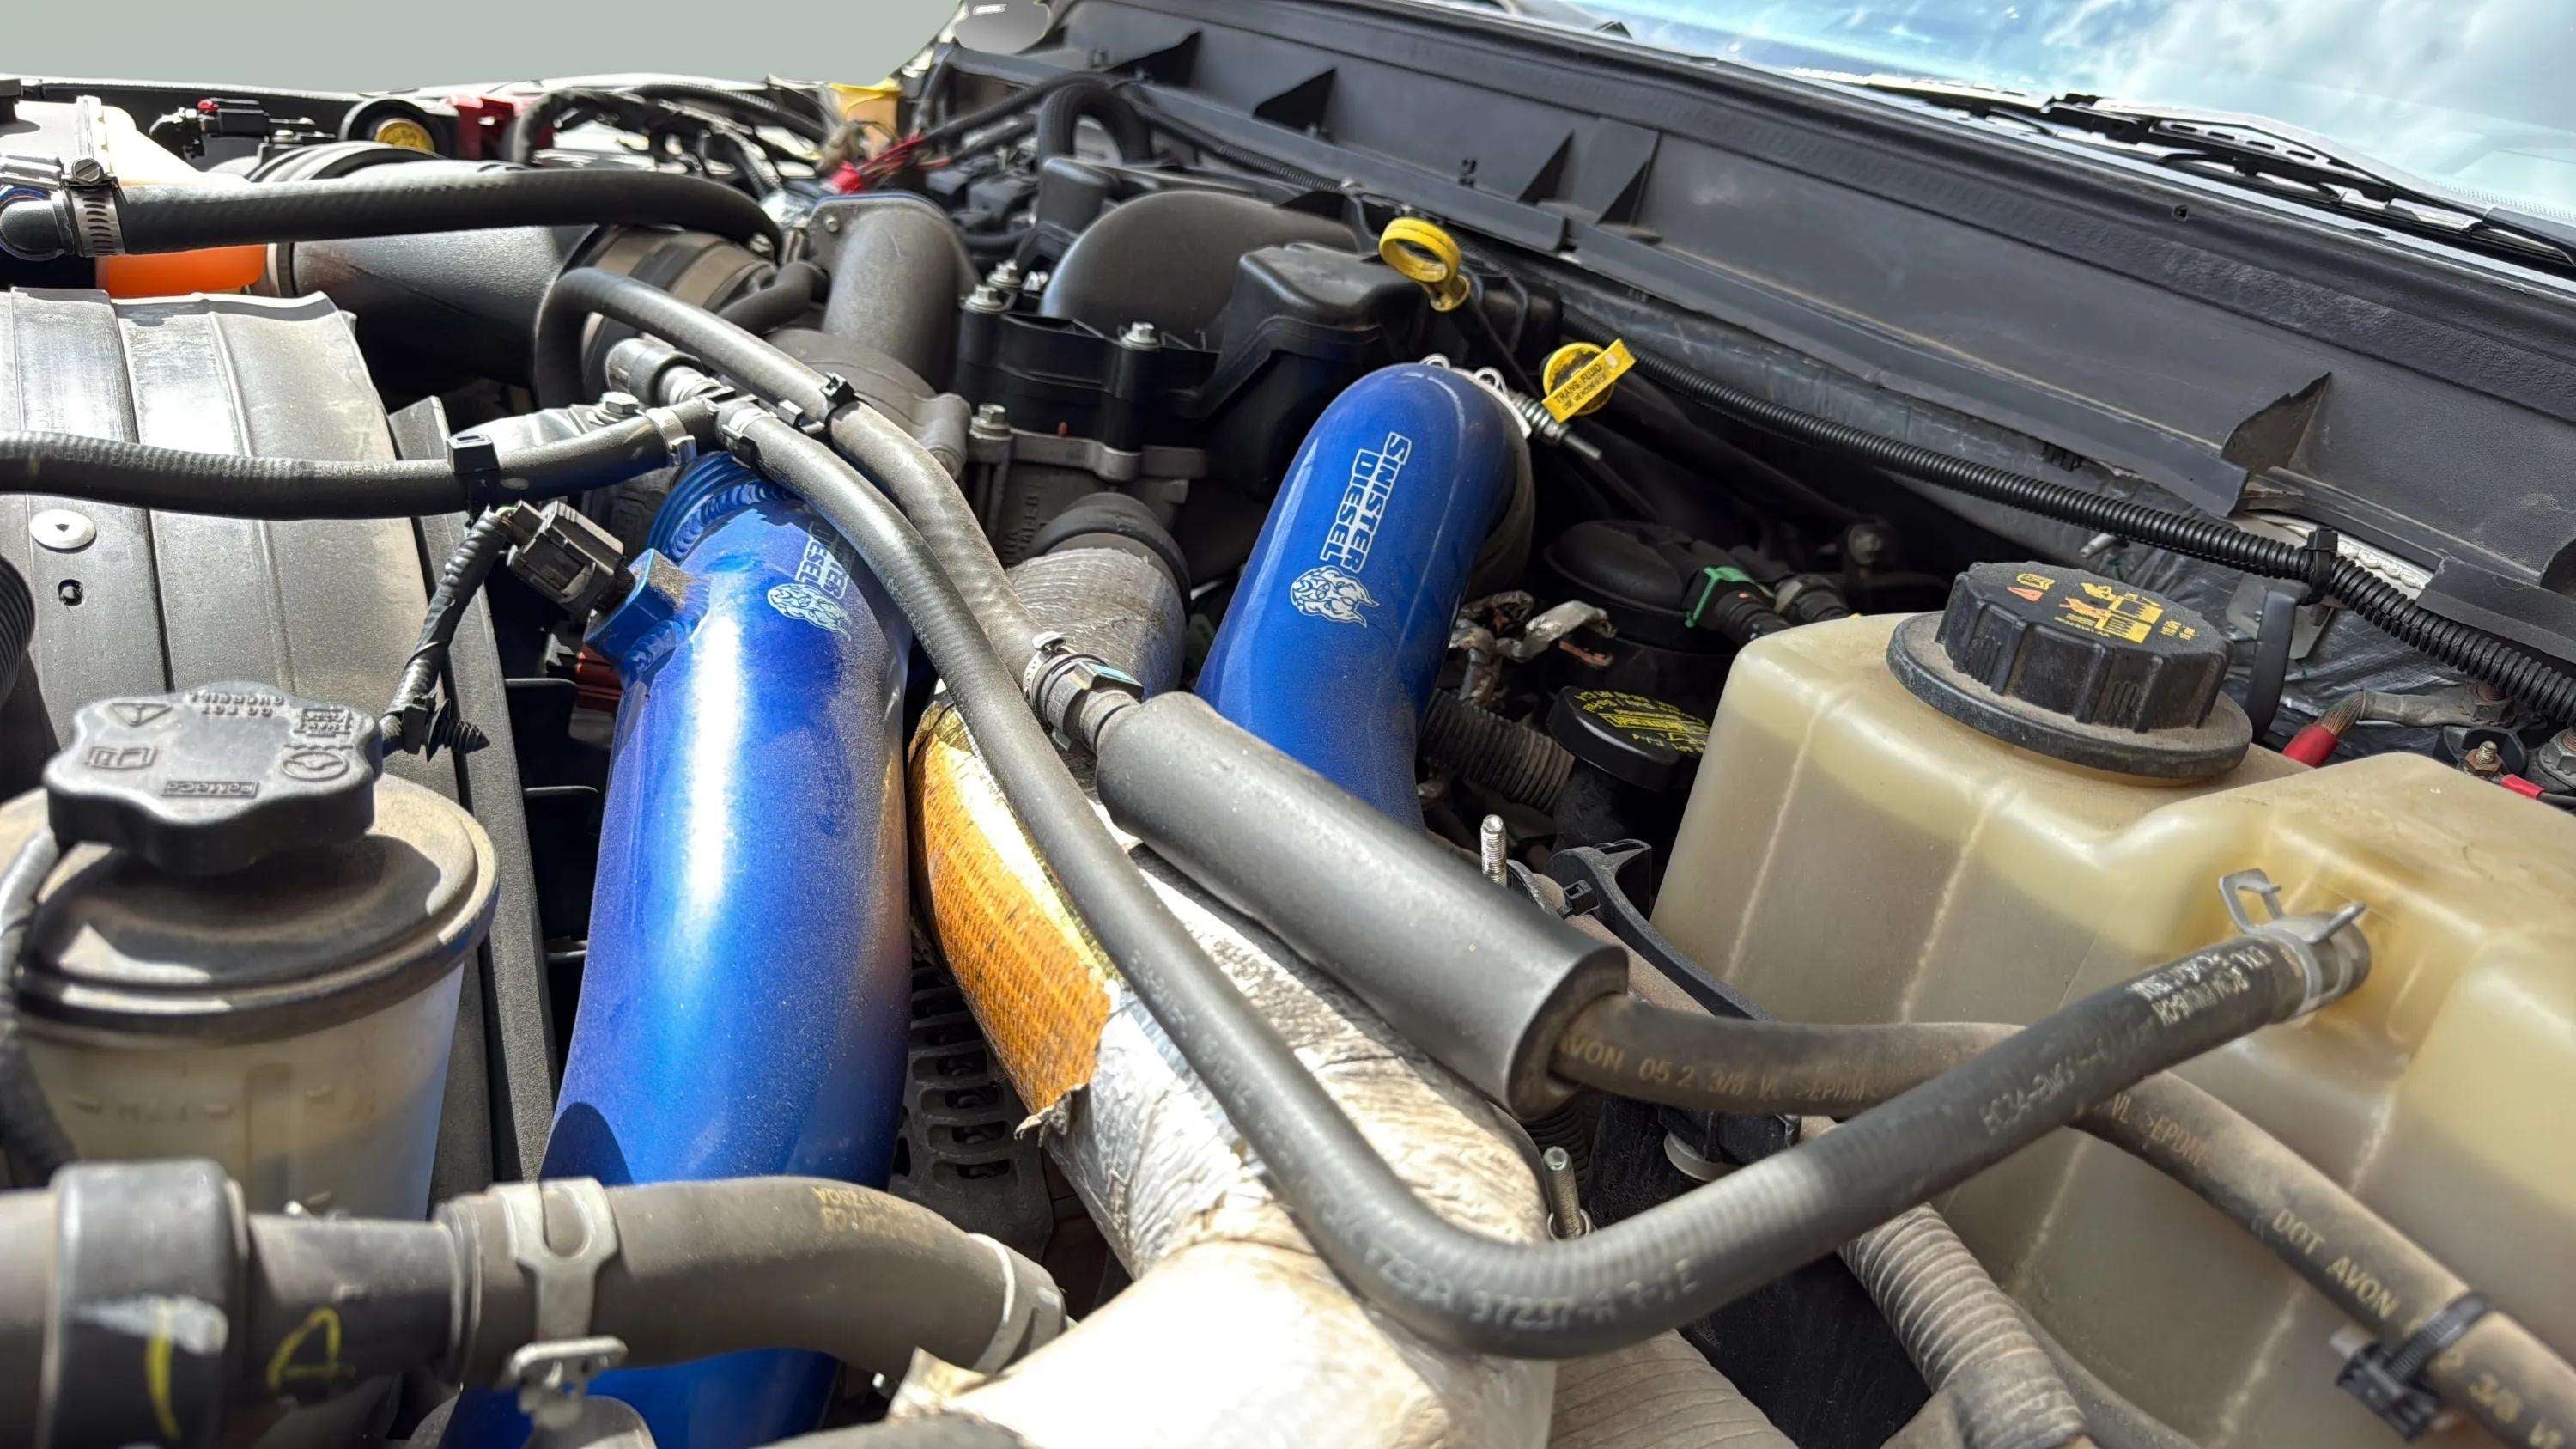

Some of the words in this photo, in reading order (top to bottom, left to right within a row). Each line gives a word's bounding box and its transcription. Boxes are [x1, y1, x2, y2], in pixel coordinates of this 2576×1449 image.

[1320, 448, 1382, 567] DIESEL
[1340, 431, 1413, 573] SINISTER
[2271, 1208, 2324, 1255] DOT
[2324, 1255, 2401, 1320] AVON
